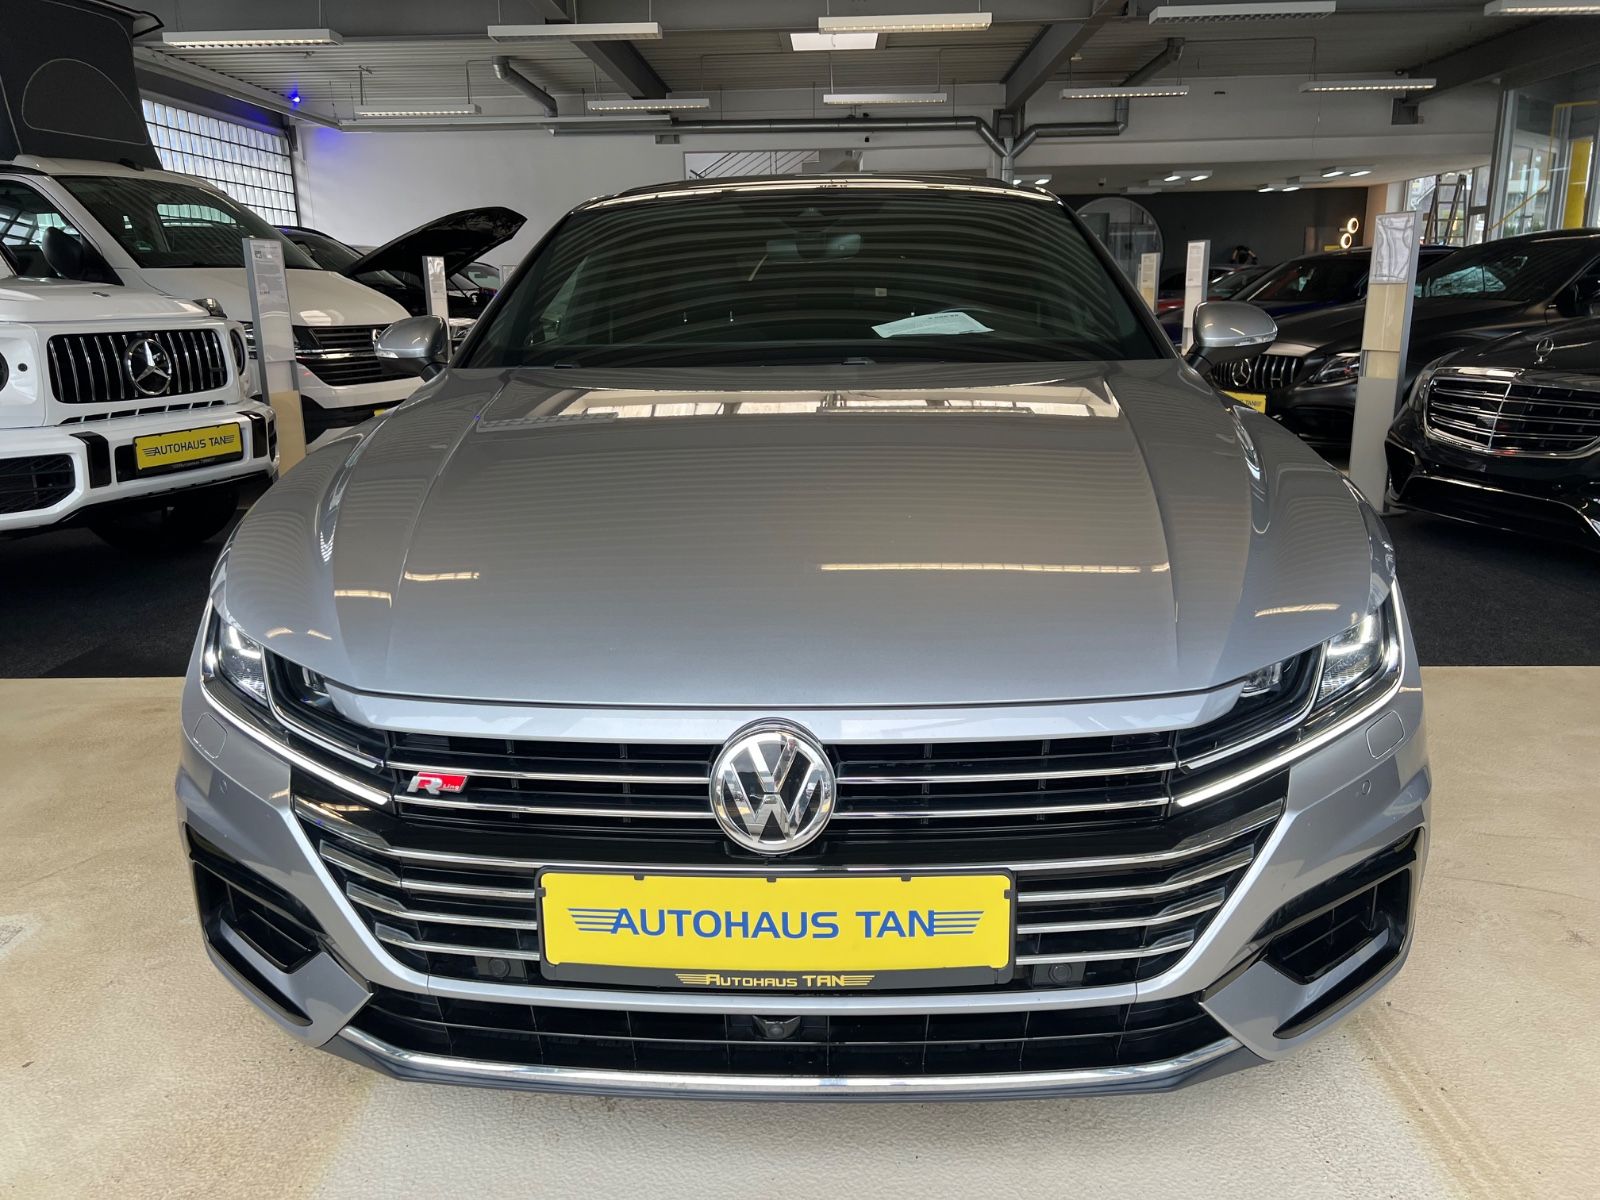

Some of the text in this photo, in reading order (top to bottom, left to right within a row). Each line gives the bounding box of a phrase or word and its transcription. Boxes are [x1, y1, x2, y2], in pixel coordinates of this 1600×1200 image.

[154, 436, 227, 456] AUTOHAUS TAN
[407, 775, 442, 795] R
[717, 730, 830, 846] VW
[611, 908, 935, 939] AUTOHAUS TAN
[802, 974, 845, 987] TAN
